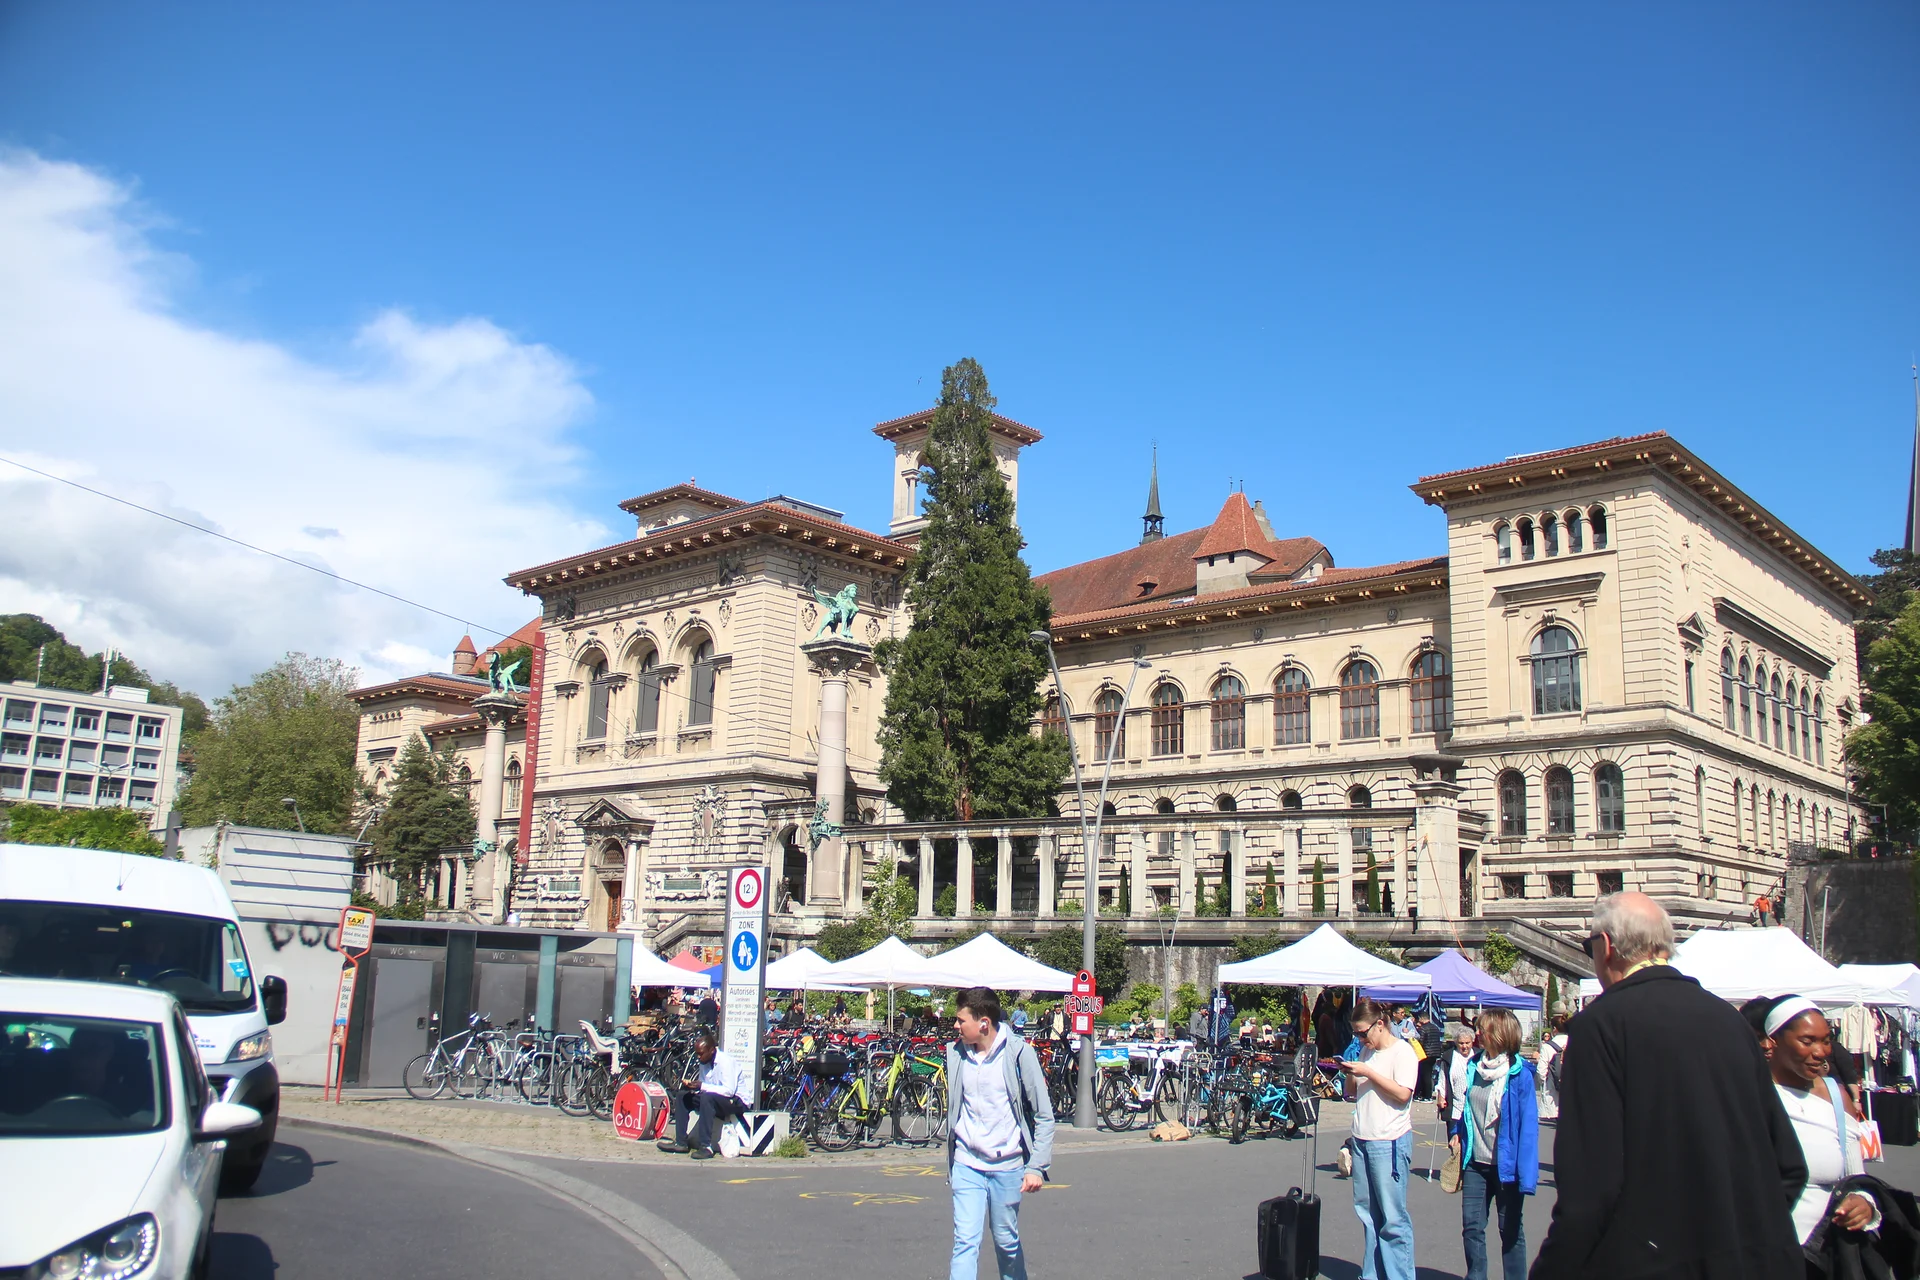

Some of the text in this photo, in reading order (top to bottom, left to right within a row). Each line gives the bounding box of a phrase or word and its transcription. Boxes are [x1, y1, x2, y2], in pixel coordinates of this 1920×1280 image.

[527, 646, 542, 764] PALAIS DE RUMINE
[738, 920, 755, 930] ZONE
[390, 947, 404, 956] WC
[492, 951, 506, 960] WC
[572, 955, 585, 964] WC
